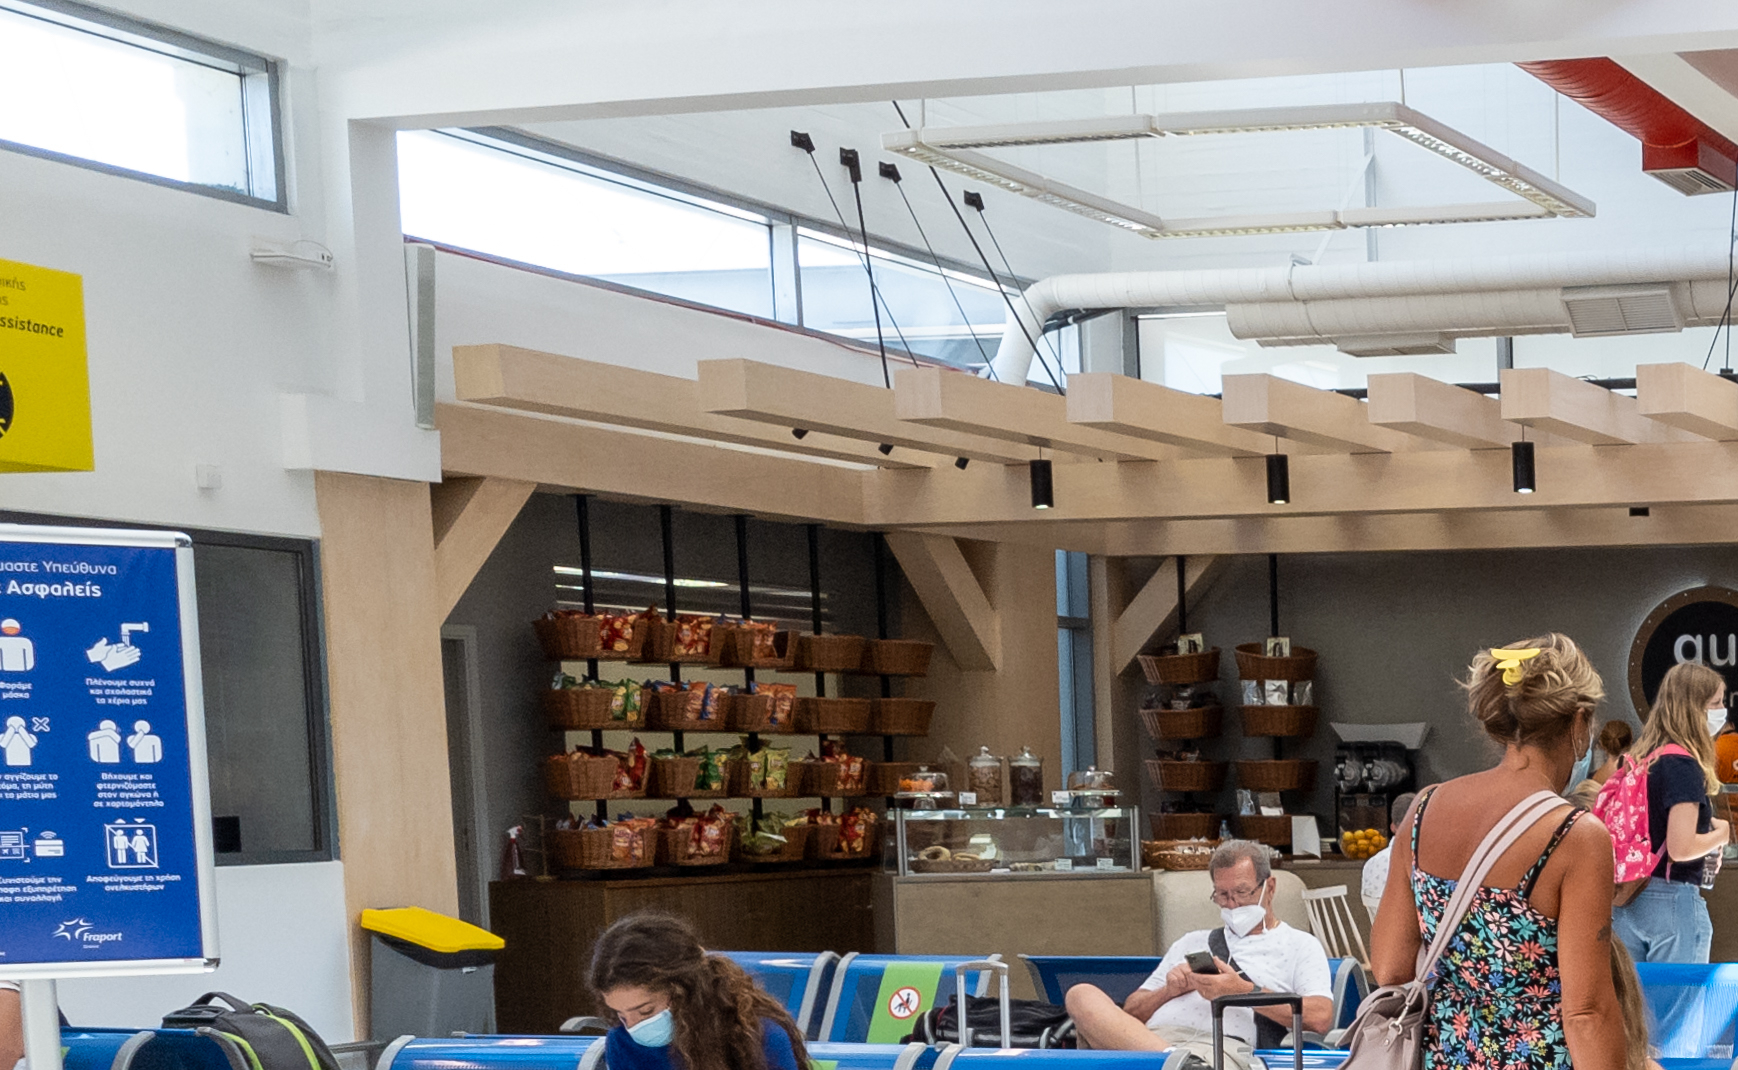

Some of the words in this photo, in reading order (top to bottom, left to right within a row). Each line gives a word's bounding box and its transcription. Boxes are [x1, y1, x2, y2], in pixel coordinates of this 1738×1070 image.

[42, 560, 117, 575] Υπεύθυνα
[7, 579, 102, 599] Ασφαλείς
[83, 932, 123, 944] Fraport
